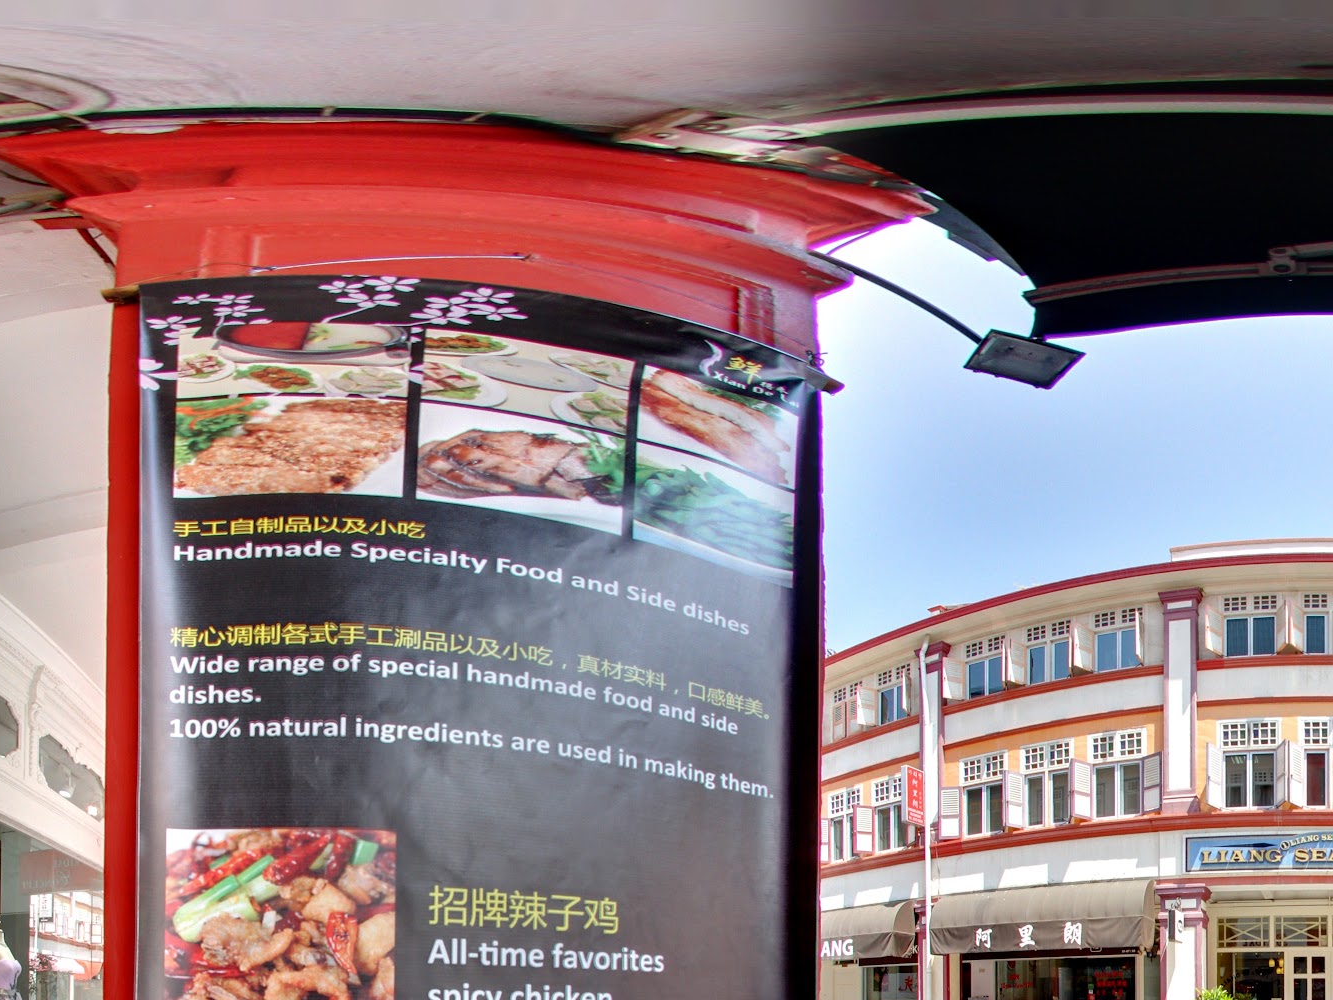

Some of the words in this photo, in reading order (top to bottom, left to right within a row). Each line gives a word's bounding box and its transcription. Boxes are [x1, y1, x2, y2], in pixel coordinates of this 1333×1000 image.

[713, 371, 746, 390] Xian
[752, 386, 774, 397] De
[173, 516, 426, 540] 手工自制品以及小吃
[173, 540, 342, 562] Handmade
[351, 542, 487, 573] Specialty
[496, 557, 563, 584] Food
[571, 570, 620, 597] and
[626, 584, 677, 613] Side
[682, 599, 751, 636] dishes
[169, 684, 262, 706] dishes.
[170, 655, 240, 675] Wide
[248, 655, 324, 680] range
[332, 652, 362, 672] of
[368, 656, 459, 686] special
[466, 663, 597, 701] handmade
[603, 684, 653, 714] food
[659, 697, 695, 724] and
[701, 708, 739, 736] side
[169, 718, 241, 739] 100%
[249, 717, 347, 738] natural
[355, 717, 504, 749] ingredients
[510, 735, 551, 756] are
[557, 737, 612, 766] used
[618, 747, 638, 769] in
[644, 752, 716, 791] making
[719, 767, 775, 800] them.
[1289, 835, 1319, 847] LIANG
[1202, 849, 1283, 864] LIANG
[428, 885, 620, 935] 招牌辣子鸡
[975, 921, 1083, 949] 阿里朗
[428, 938, 545, 969] All-time
[552, 943, 664, 973] favorites
